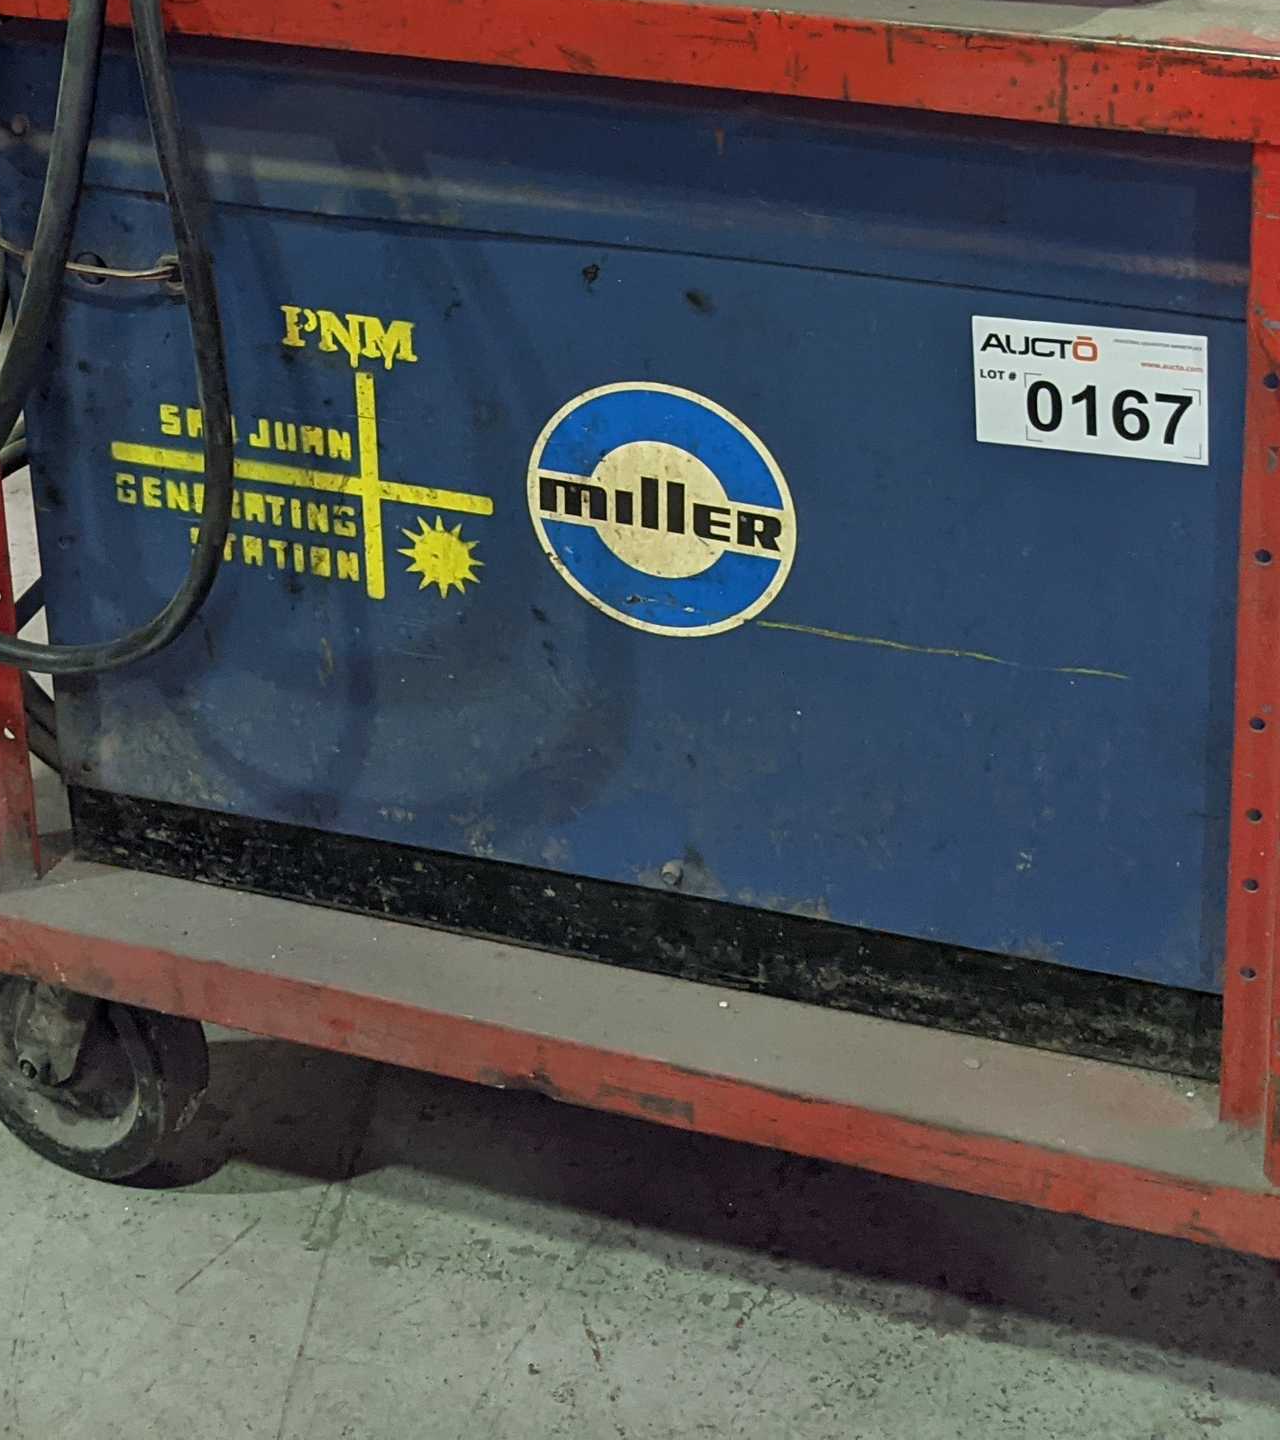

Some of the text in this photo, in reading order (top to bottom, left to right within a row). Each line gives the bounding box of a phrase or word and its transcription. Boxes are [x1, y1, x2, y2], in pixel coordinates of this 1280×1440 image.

[280, 305, 418, 370] PNM
[980, 369, 1005, 381] LOT
[160, 404, 353, 461] SA JUAN
[1027, 380, 1194, 446] 0167
